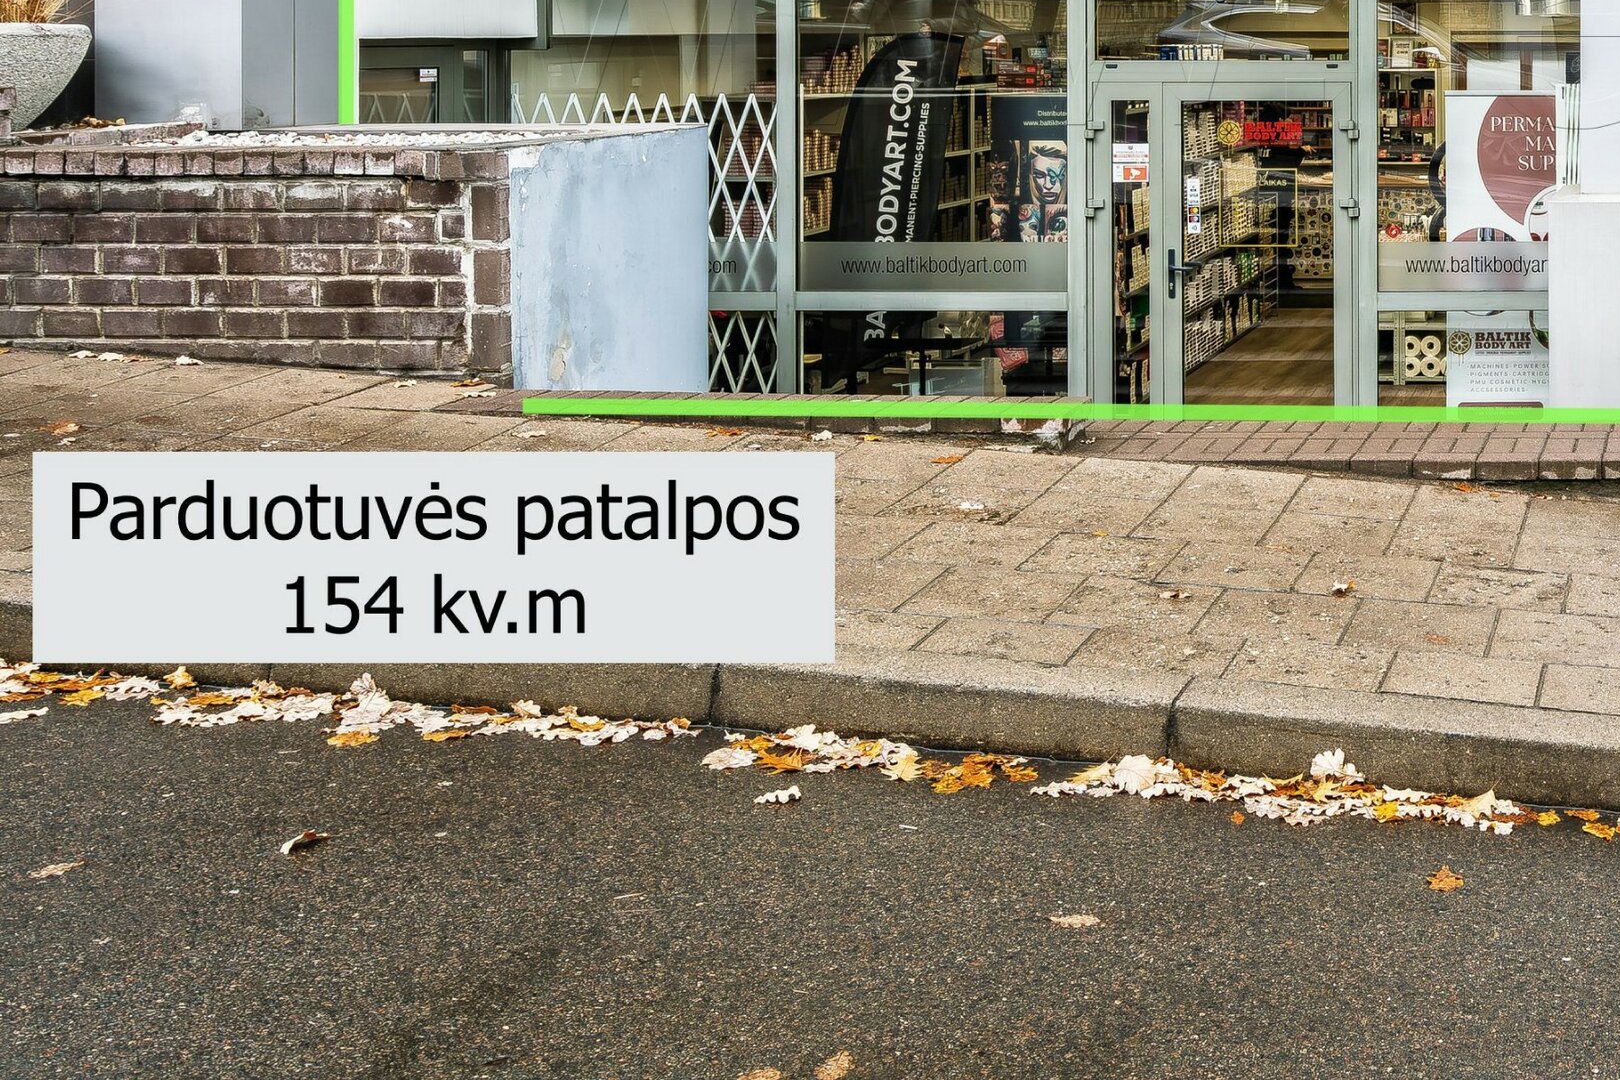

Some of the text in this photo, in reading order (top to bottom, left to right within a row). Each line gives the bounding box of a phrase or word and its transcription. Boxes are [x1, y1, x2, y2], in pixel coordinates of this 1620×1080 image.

[1490, 115, 1556, 132] PERMA
[1525, 135, 1555, 152] MA
[840, 255, 1027, 281] www.baltikbodyart.com
[1474, 331, 1532, 341] BALTIK
